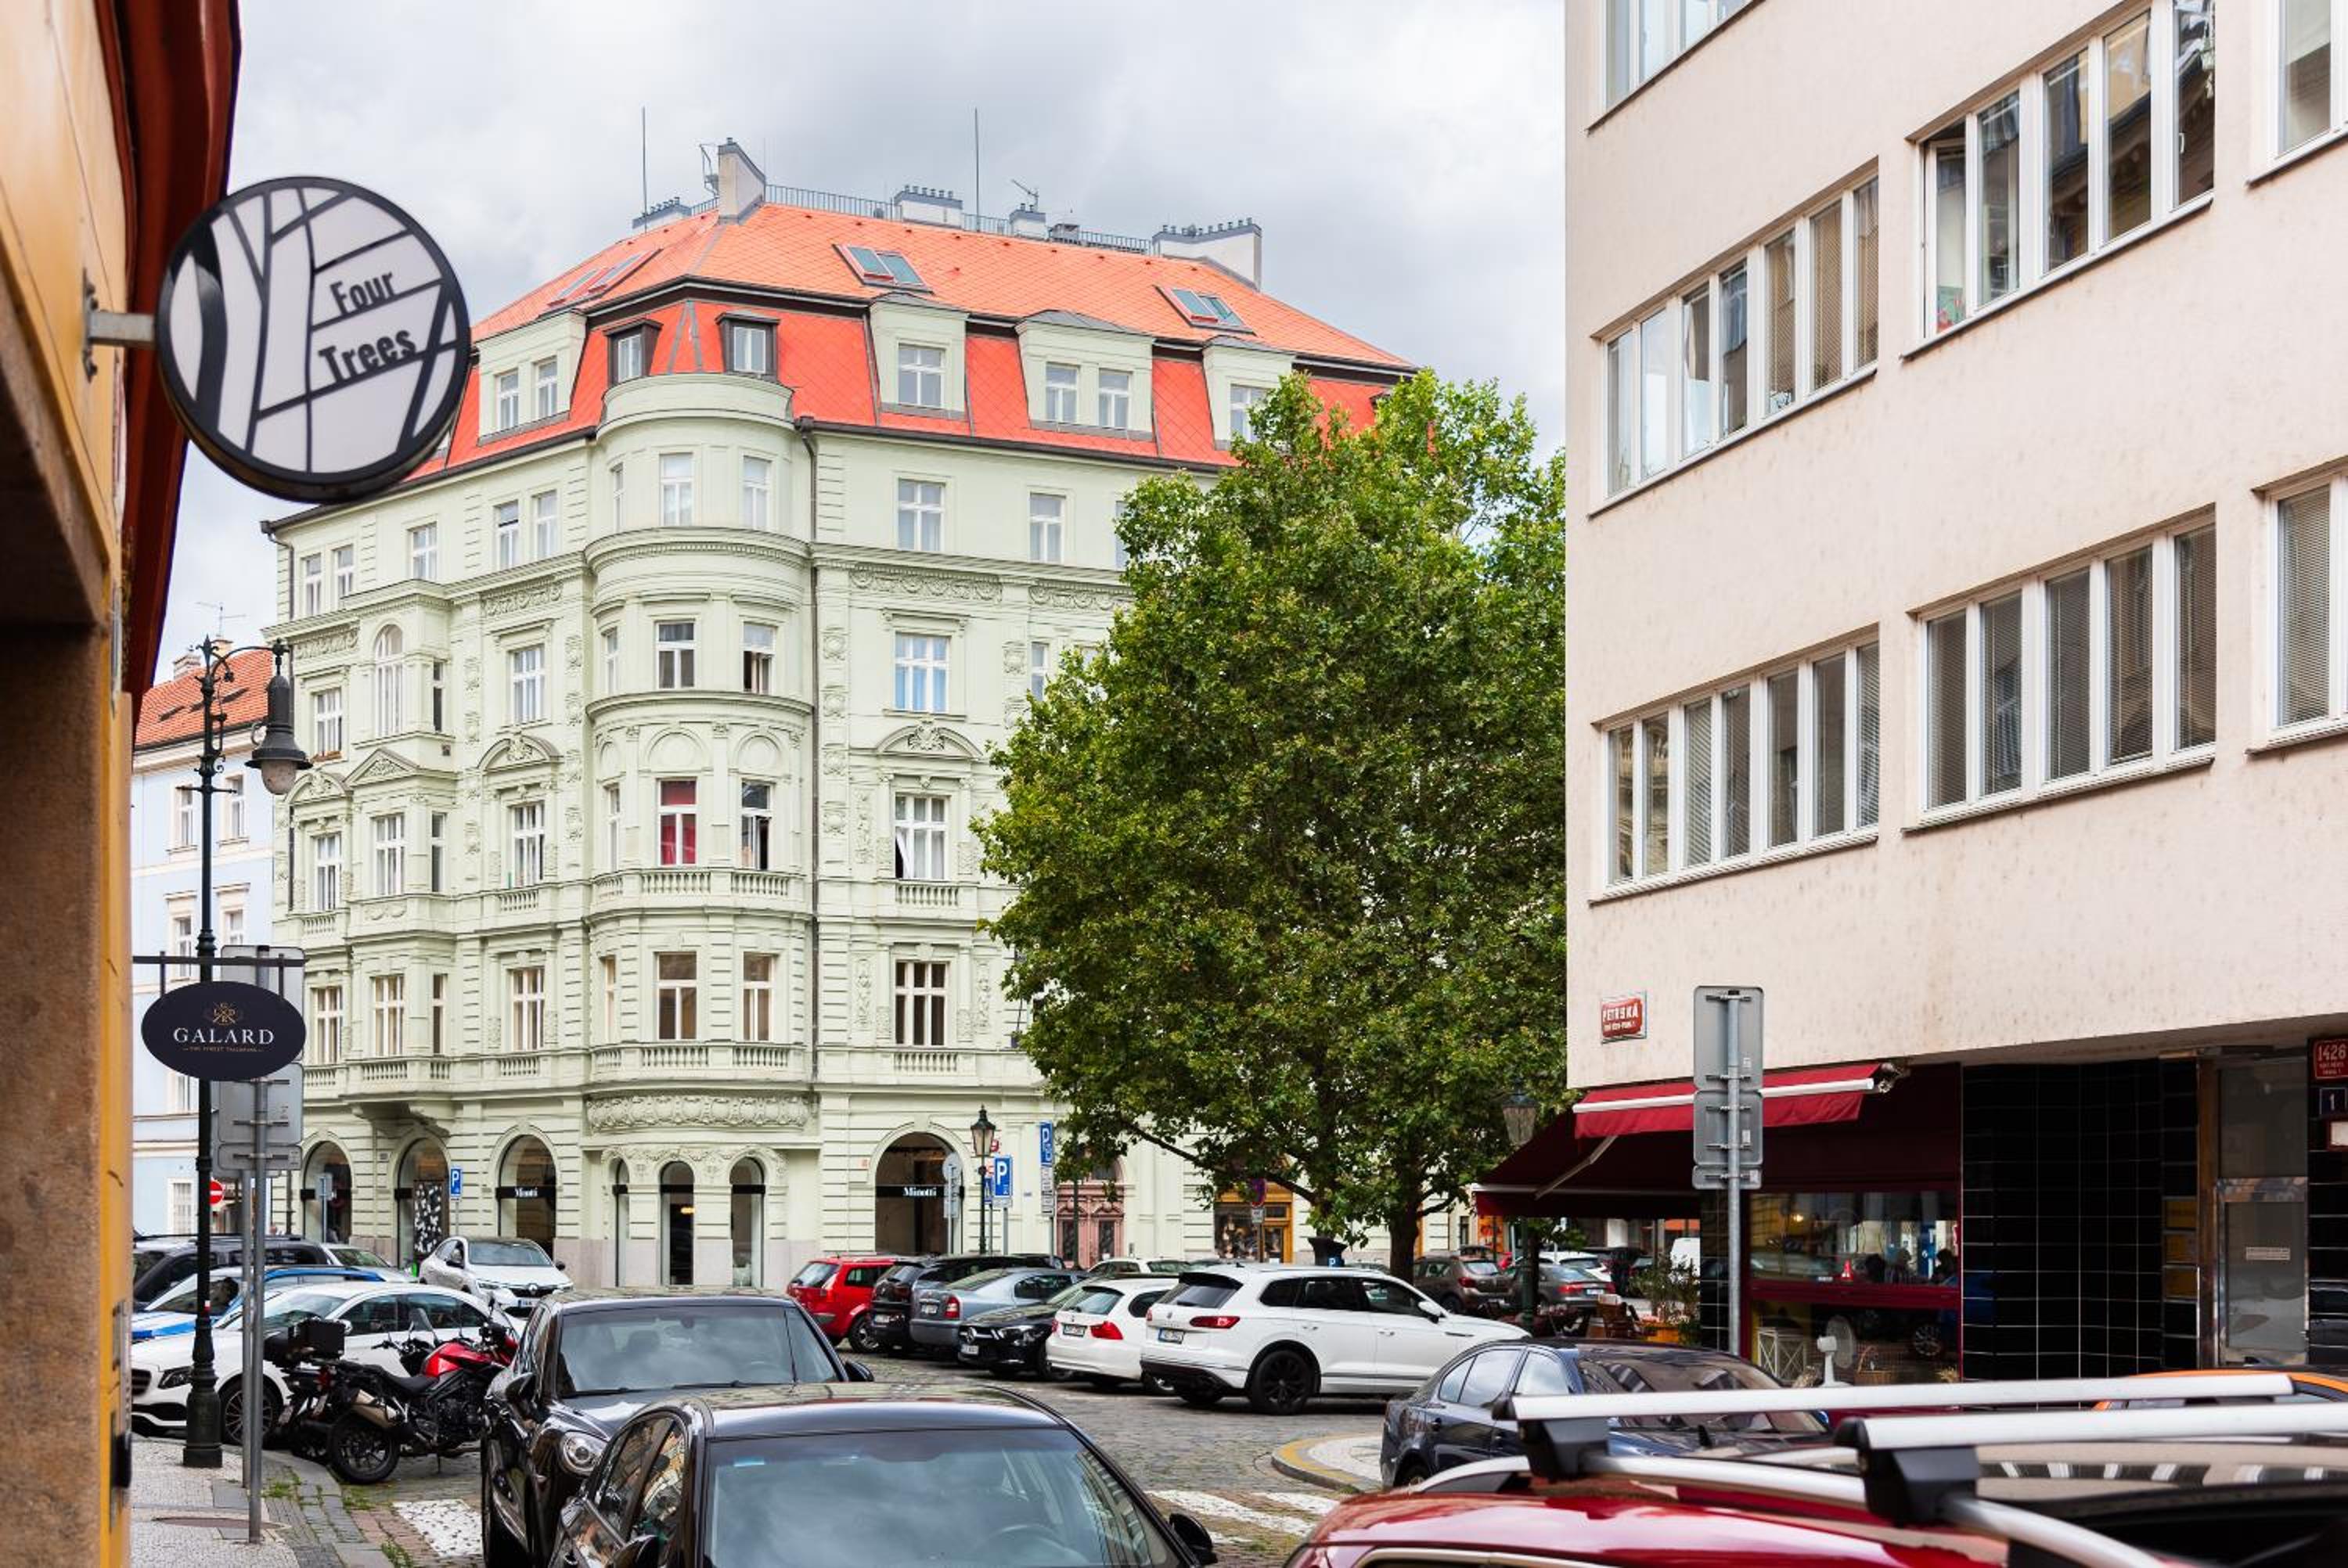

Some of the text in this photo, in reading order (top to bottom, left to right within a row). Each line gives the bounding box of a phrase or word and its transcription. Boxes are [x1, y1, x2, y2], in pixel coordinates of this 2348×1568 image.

[330, 271, 394, 315] Four
[319, 329, 416, 381] Trees
[173, 1027, 274, 1045] GALARD
[452, 1171, 459, 1186] P
[996, 1160, 1007, 1185] P
[902, 1186, 938, 1197] Minotti
